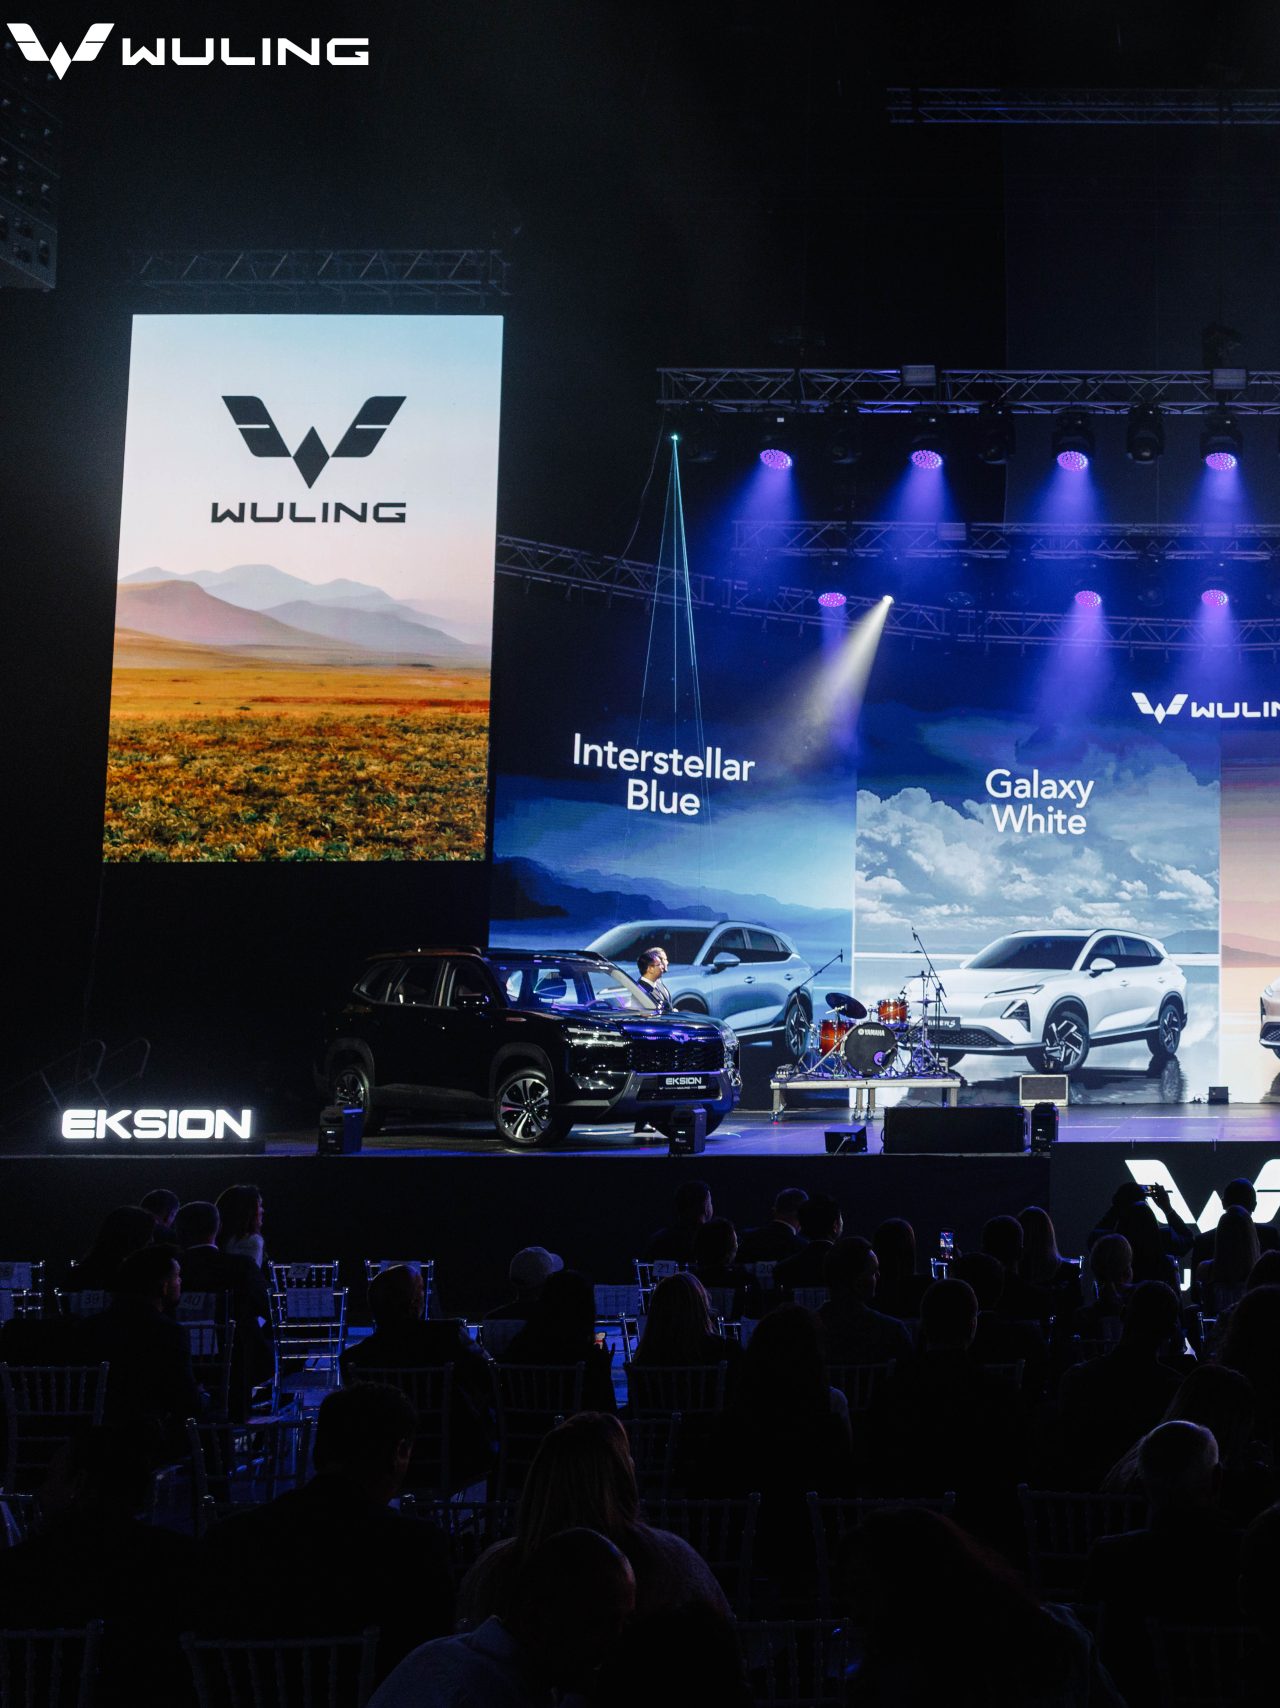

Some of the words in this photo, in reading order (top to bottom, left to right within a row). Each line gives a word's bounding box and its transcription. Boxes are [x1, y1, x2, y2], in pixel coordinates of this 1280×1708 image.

[210, 502, 407, 523] WULING
[573, 732, 756, 781] Interstellar
[627, 778, 701, 816] Blue
[985, 768, 1095, 809] Galaxy
[991, 803, 1087, 835] White
[864, 1029, 886, 1037] YAMAHA
[665, 1076, 702, 1086] EKSION
[61, 1109, 252, 1139] EKSION
